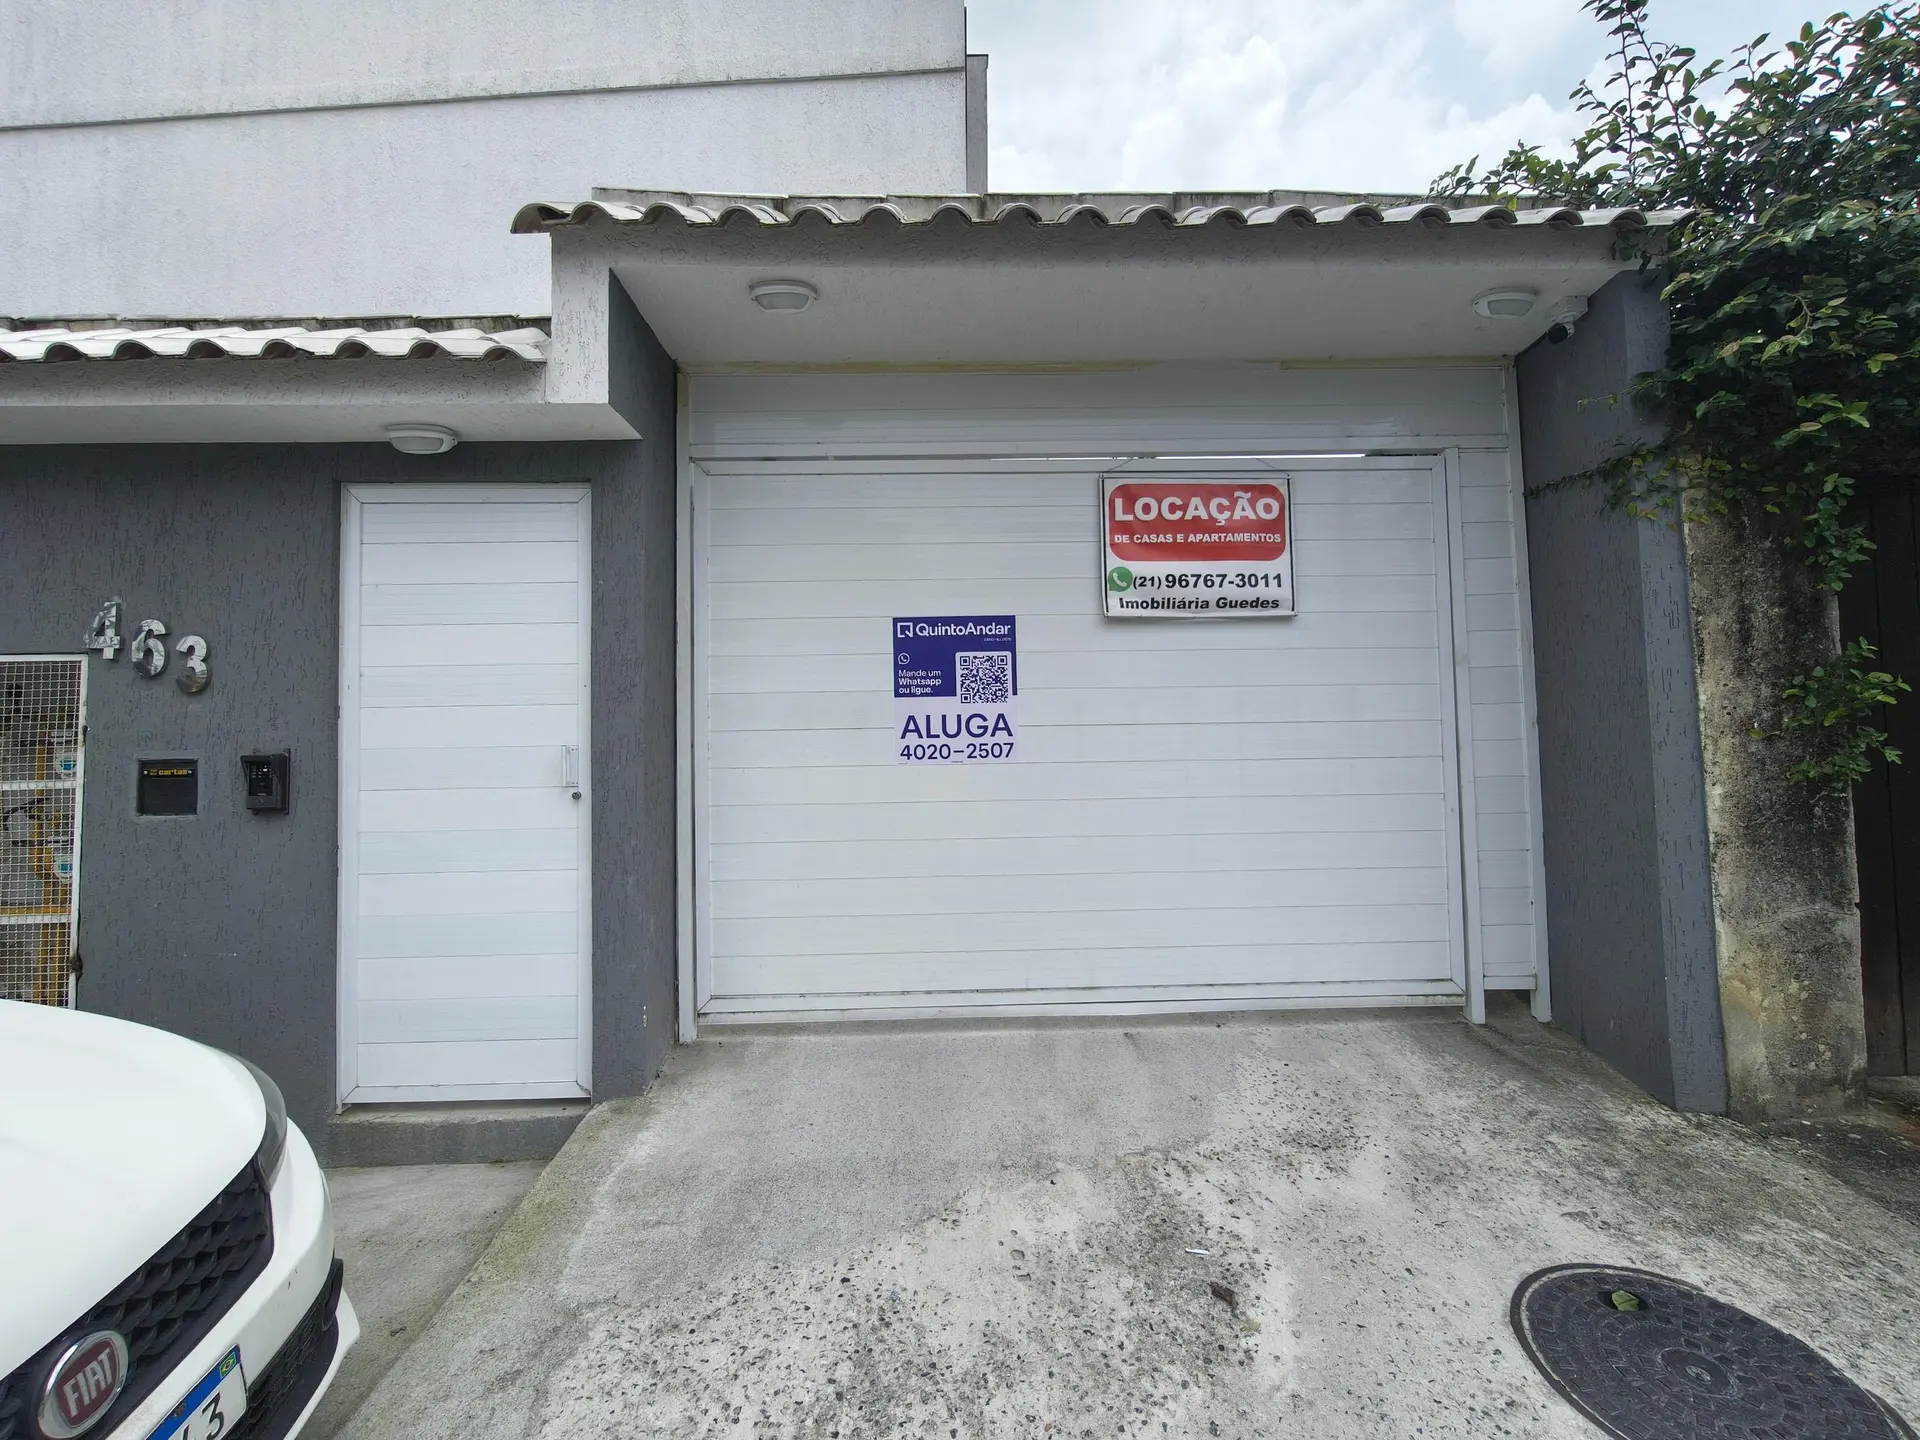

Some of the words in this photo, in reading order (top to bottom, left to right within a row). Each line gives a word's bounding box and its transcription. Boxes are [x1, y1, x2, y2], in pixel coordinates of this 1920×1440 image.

[1114, 491, 1280, 526] LOCAÇÃO
[1114, 534, 1130, 543] DE
[1133, 534, 1173, 543] CASAS
[1176, 533, 1184, 543] E
[1187, 533, 1282, 543] APARTAMENTOS
[1132, 575, 1162, 590] (21)
[1164, 573, 1282, 589] 96767-3011
[1118, 597, 1210, 610] Imobiliária
[1215, 597, 1280, 609] Guedes
[915, 622, 1011, 637] QuintoAndar
[83, 600, 210, 694] 463
[898, 669, 927, 677] Mande
[898, 677, 942, 686] Whatsapp
[911, 685, 934, 695] ligue.
[900, 713, 1013, 739] ALUGA
[900, 742, 1014, 760] 4020-2507
[63, 1347, 113, 1418] FIAT
